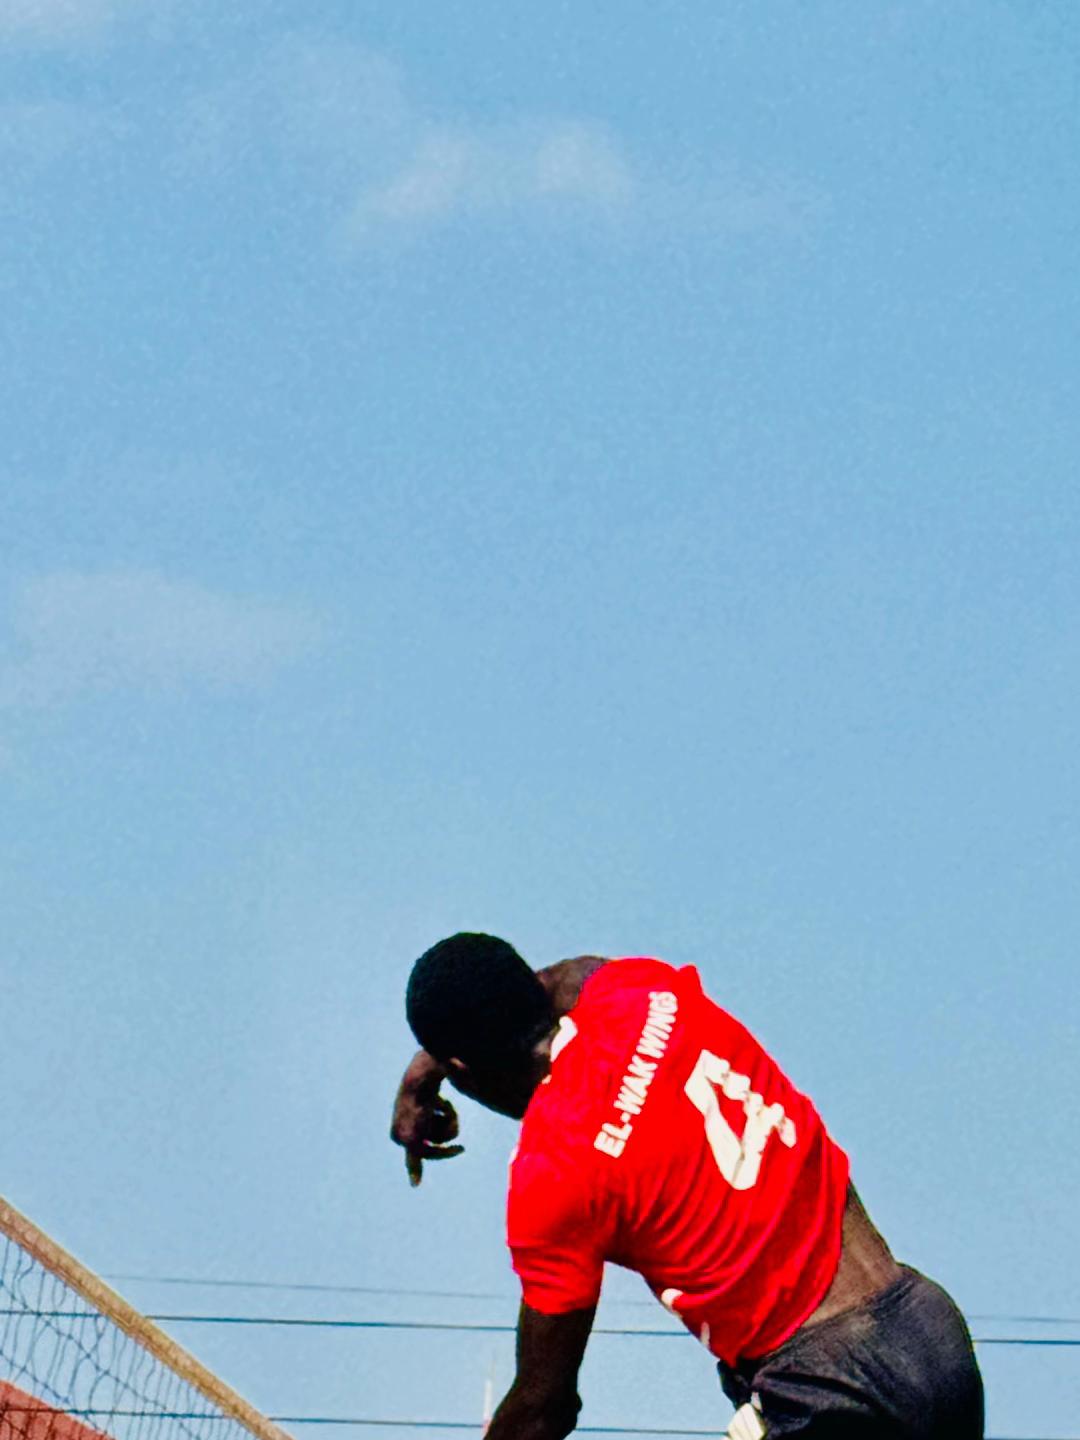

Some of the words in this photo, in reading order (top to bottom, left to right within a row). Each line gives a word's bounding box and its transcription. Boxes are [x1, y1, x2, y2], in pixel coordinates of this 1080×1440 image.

[594, 1055, 658, 1158] EL-WAK
[636, 991, 678, 1059] WINGS
[684, 1049, 797, 1190] 4
